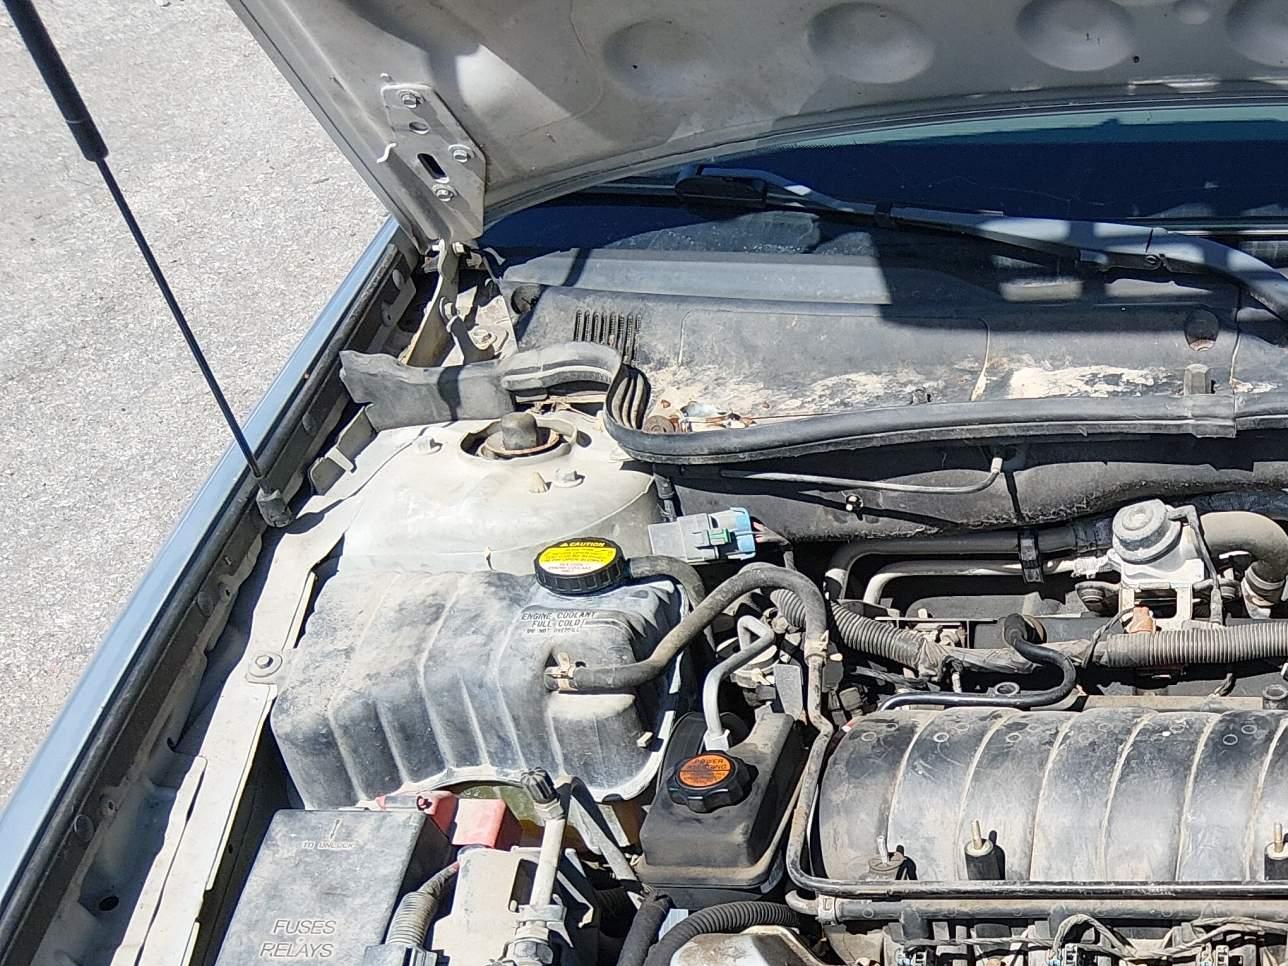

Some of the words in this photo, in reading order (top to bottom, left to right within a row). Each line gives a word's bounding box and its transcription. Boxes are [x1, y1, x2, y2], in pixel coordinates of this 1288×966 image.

[521, 612, 552, 620] ENGINE
[556, 611, 596, 619] COOLANT
[532, 620, 552, 628] FULL
[273, 920, 337, 934] FUSES
[260, 943, 334, 957] RELAYS
